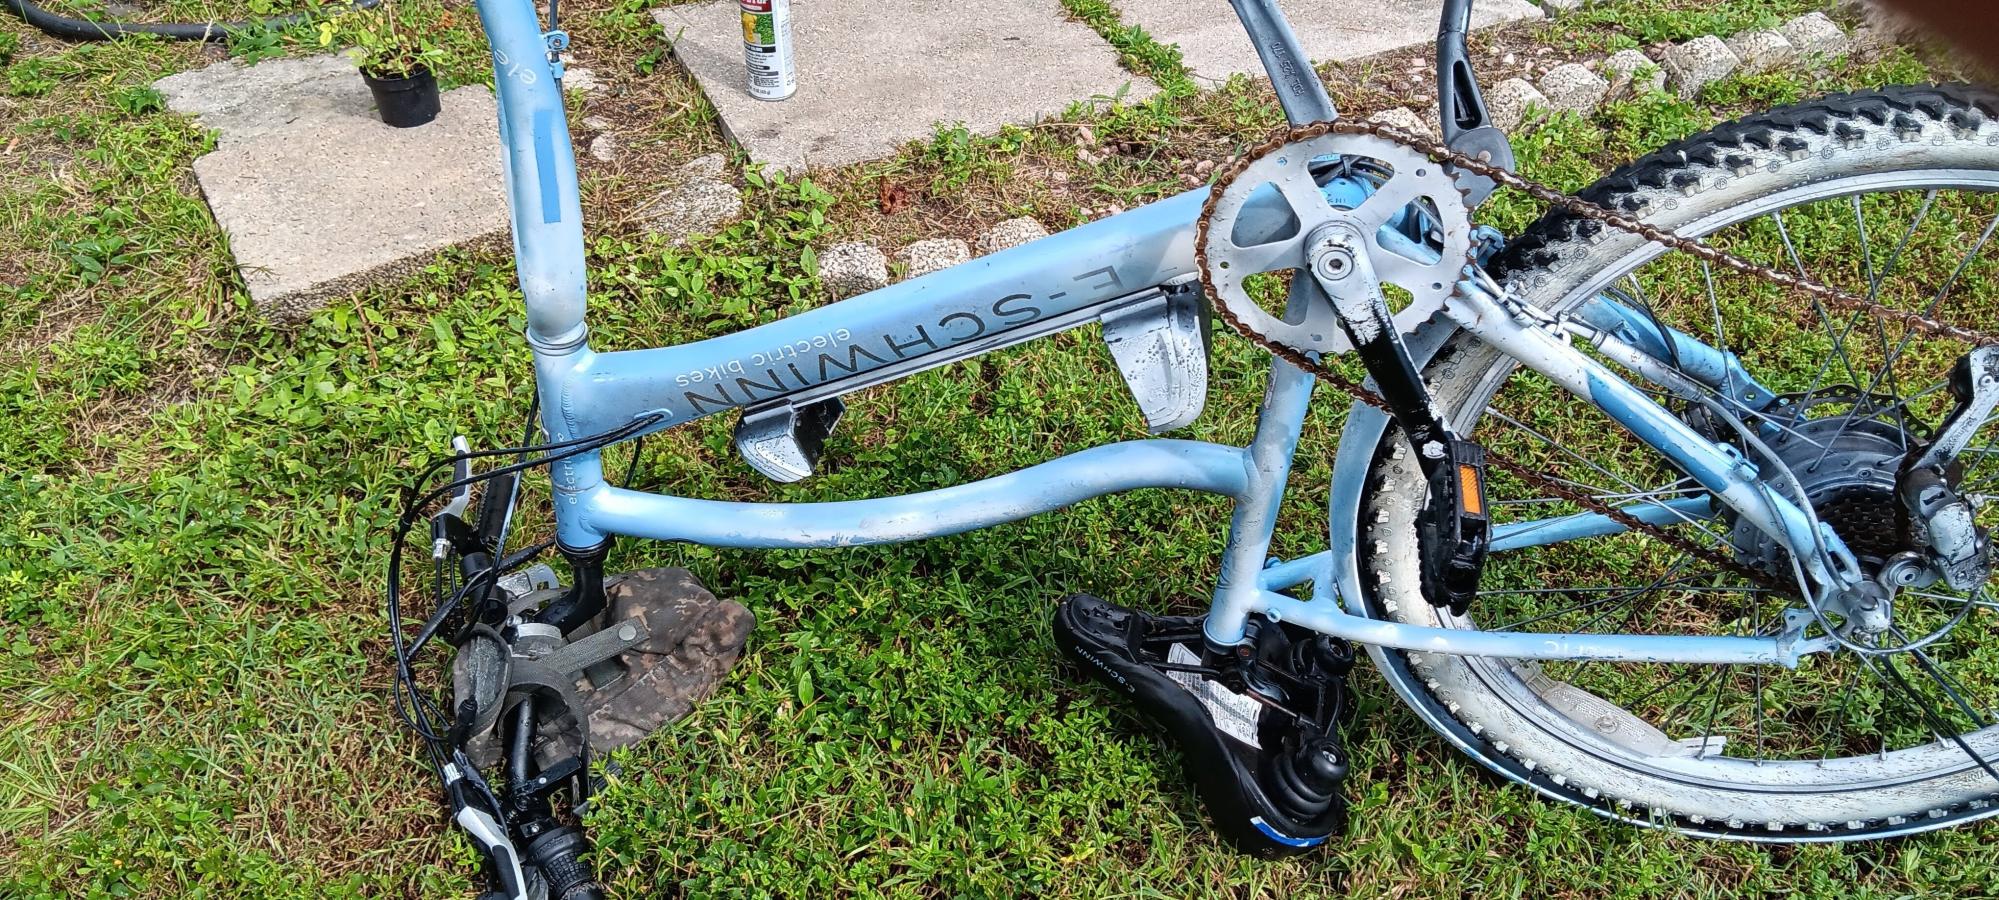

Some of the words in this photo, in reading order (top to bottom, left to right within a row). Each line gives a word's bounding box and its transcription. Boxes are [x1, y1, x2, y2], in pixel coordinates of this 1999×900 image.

[751, 328, 851, 366] electric
[675, 359, 745, 387] bikes
[561, 455, 578, 505] electri
